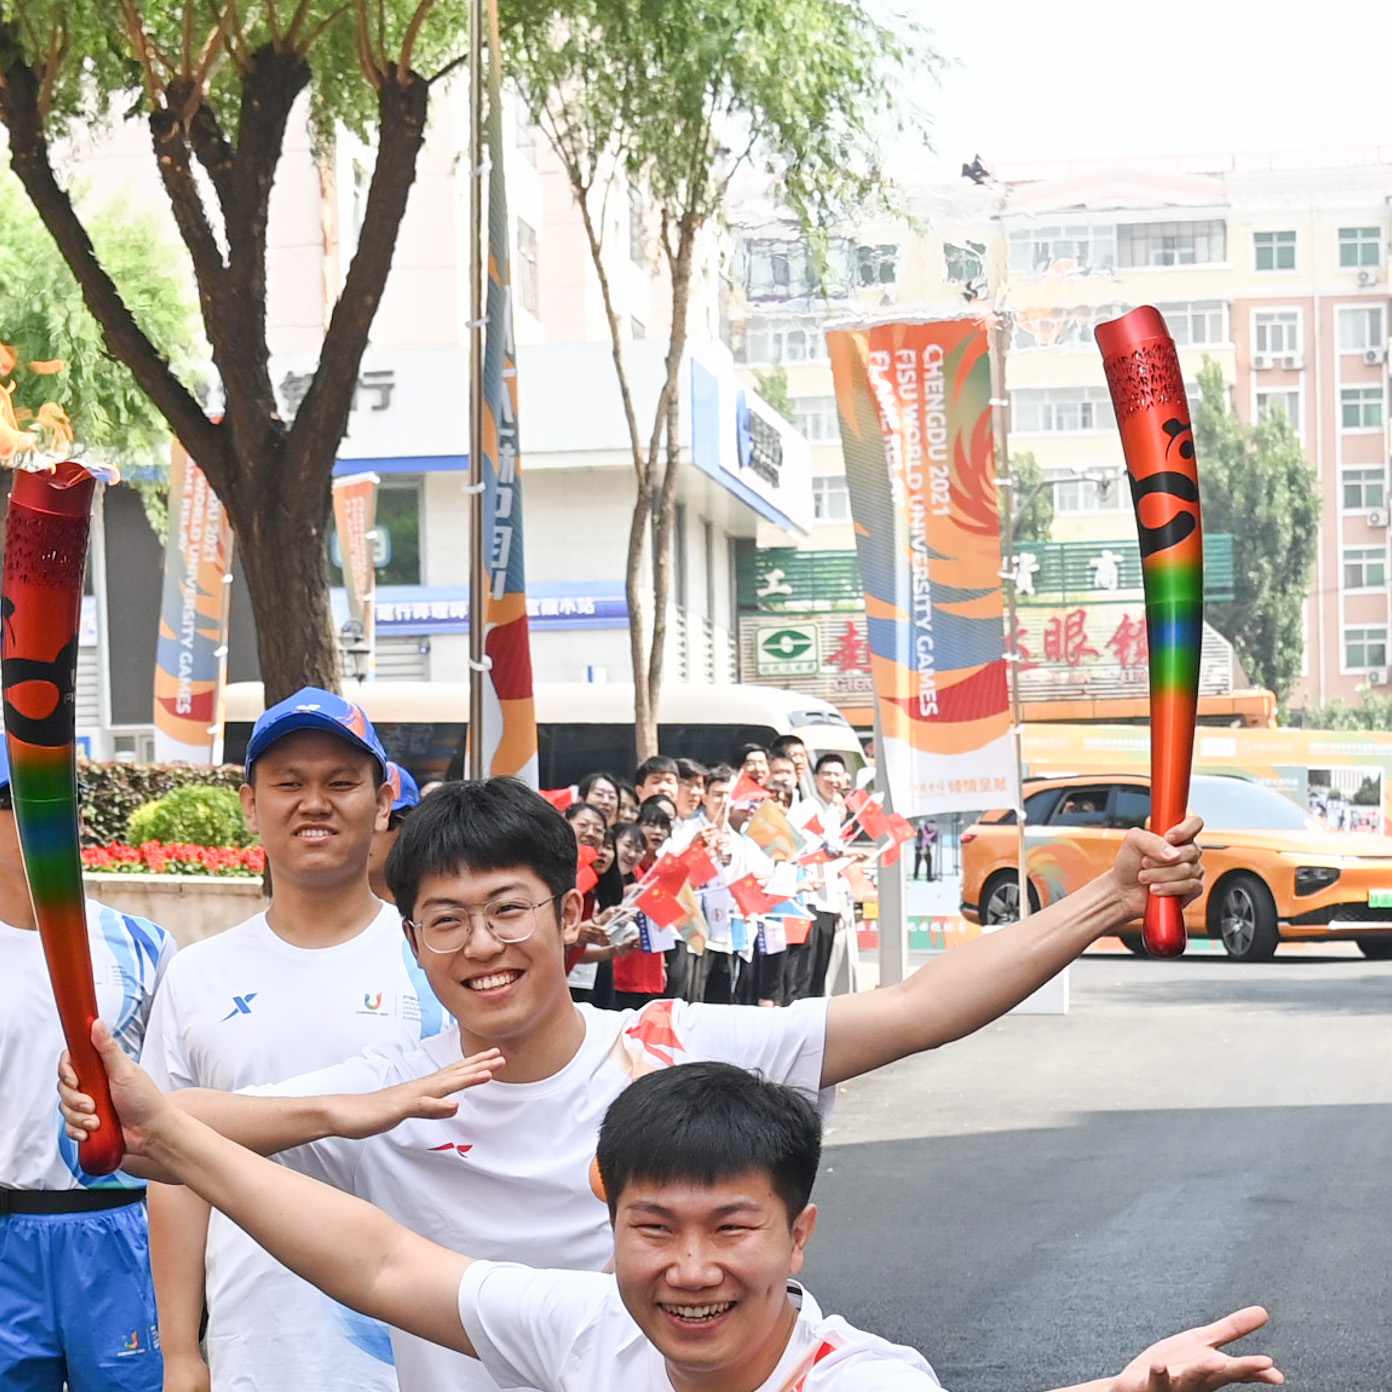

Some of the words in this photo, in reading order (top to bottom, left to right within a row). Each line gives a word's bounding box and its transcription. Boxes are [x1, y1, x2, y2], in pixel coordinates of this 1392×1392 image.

[895, 348, 918, 401] FISU
[923, 343, 947, 461] CHENGDU
[901, 402, 924, 490] WORLD
[929, 463, 951, 516] 2021
[181, 543, 201, 648] UNIVERSITY
[909, 495, 932, 632] UNIVERSITY
[176, 652, 194, 715] GAMES
[916, 634, 939, 717] GAMES
